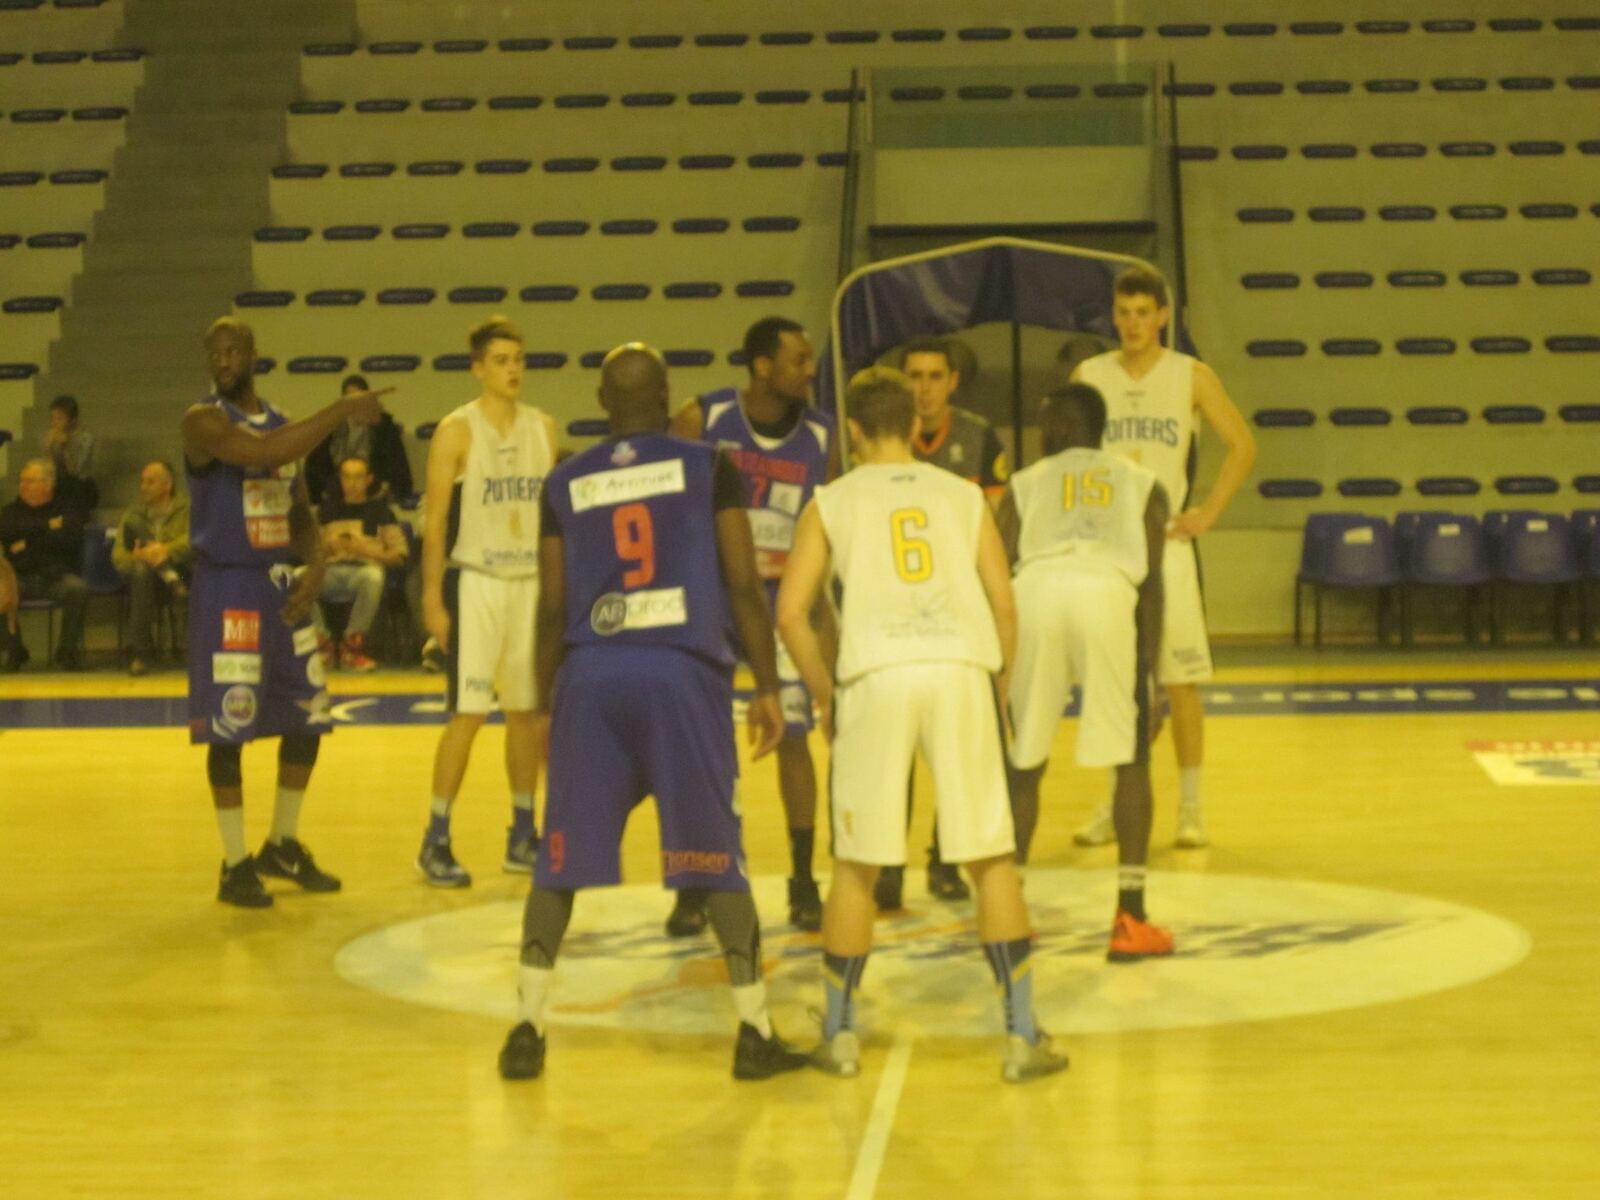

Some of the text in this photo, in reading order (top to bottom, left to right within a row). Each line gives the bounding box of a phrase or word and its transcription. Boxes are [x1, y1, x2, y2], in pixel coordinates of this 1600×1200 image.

[1102, 416, 1179, 448] OITIERS
[1062, 467, 1114, 513] 15
[612, 502, 655, 588] 9
[890, 507, 933, 584] 6
[549, 831, 566, 873] 9
